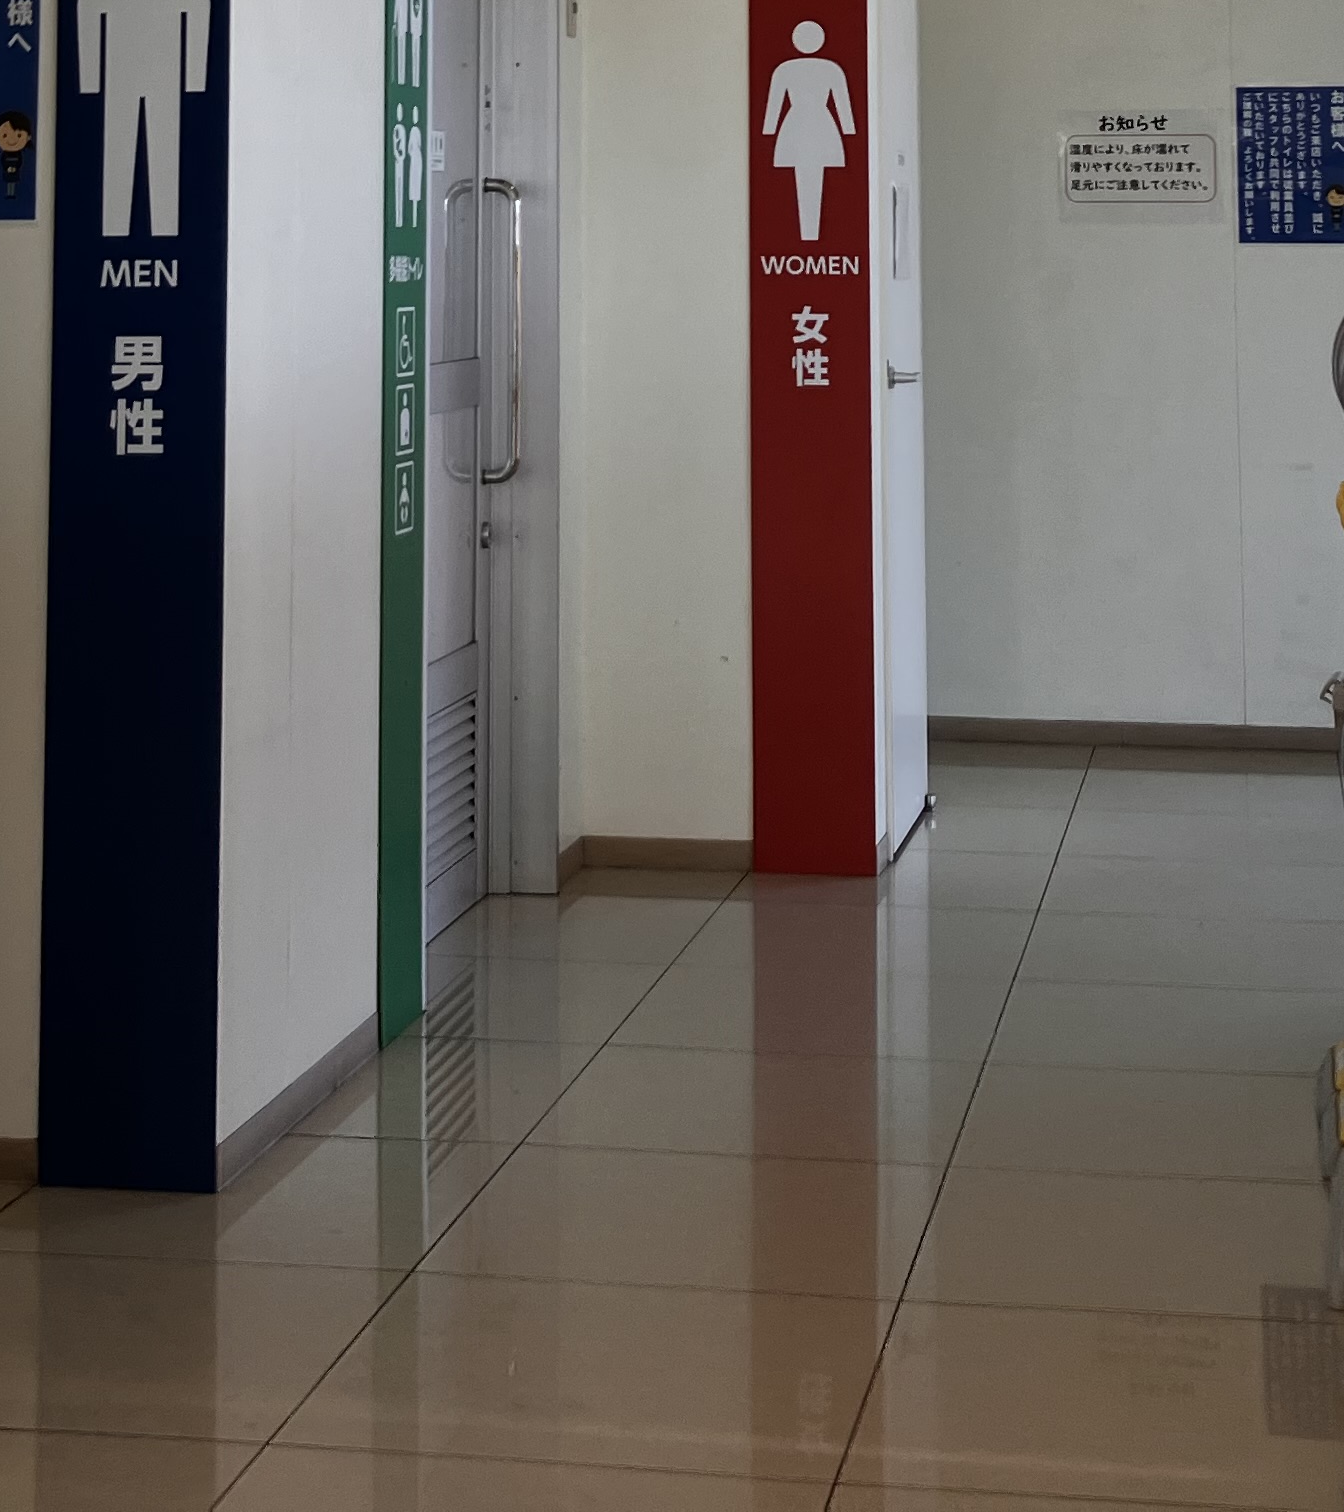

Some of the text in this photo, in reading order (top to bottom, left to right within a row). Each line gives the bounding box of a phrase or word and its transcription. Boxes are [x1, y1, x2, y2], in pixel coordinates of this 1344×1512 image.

[1099, 115, 1168, 131] お知らせ
[100, 259, 178, 288] MEN
[760, 255, 859, 276] WOMEN
[791, 305, 830, 387] 女性
[109, 335, 164, 456] 男性
